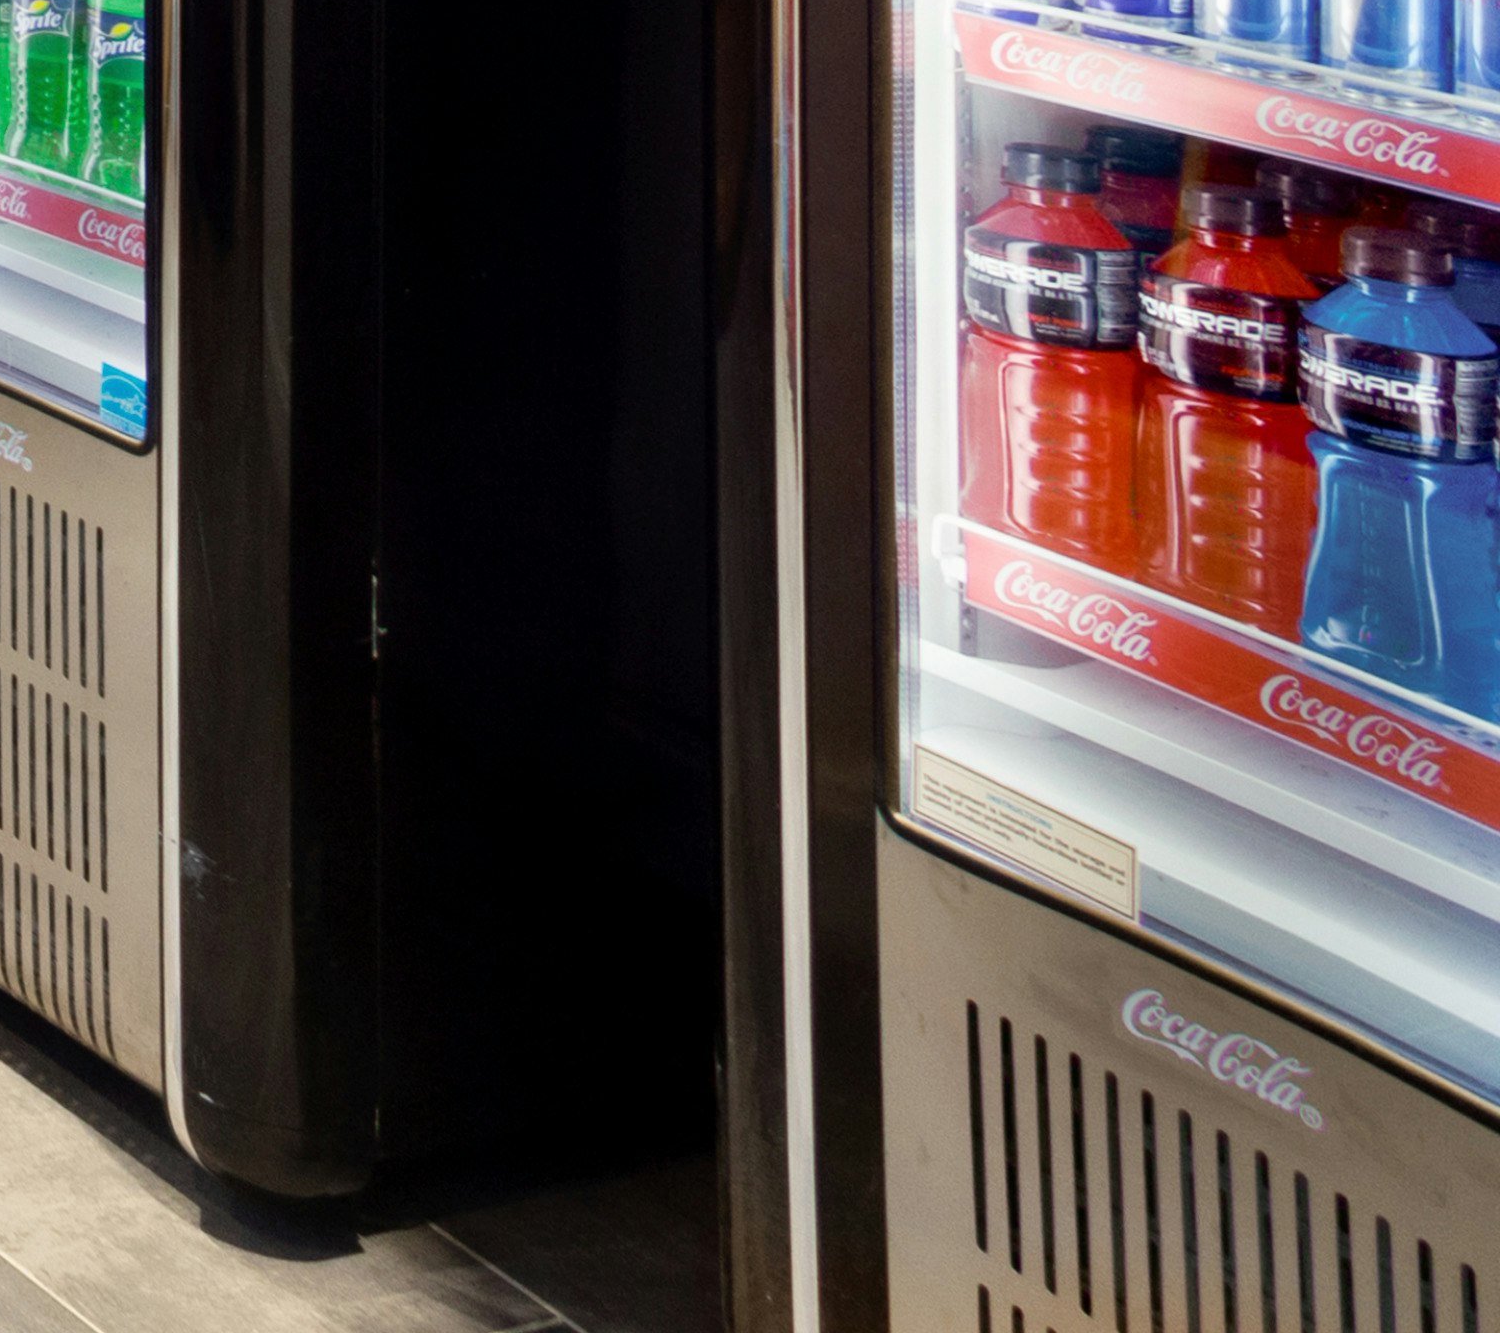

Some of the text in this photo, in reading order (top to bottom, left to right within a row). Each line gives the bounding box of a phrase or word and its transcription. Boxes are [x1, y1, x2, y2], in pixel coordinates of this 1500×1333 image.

[13, 9, 63, 38] Sprite
[94, 32, 147, 61] Sprite
[991, 30, 1147, 104] Coca-Cola
[1257, 95, 1440, 175] Coca-Cola
[78, 208, 146, 258] Coca-Co
[993, 559, 1159, 662] Coca-Cola
[1259, 674, 1444, 789] Coca-Cola
[1122, 988, 1313, 1113] Coca-Cola
